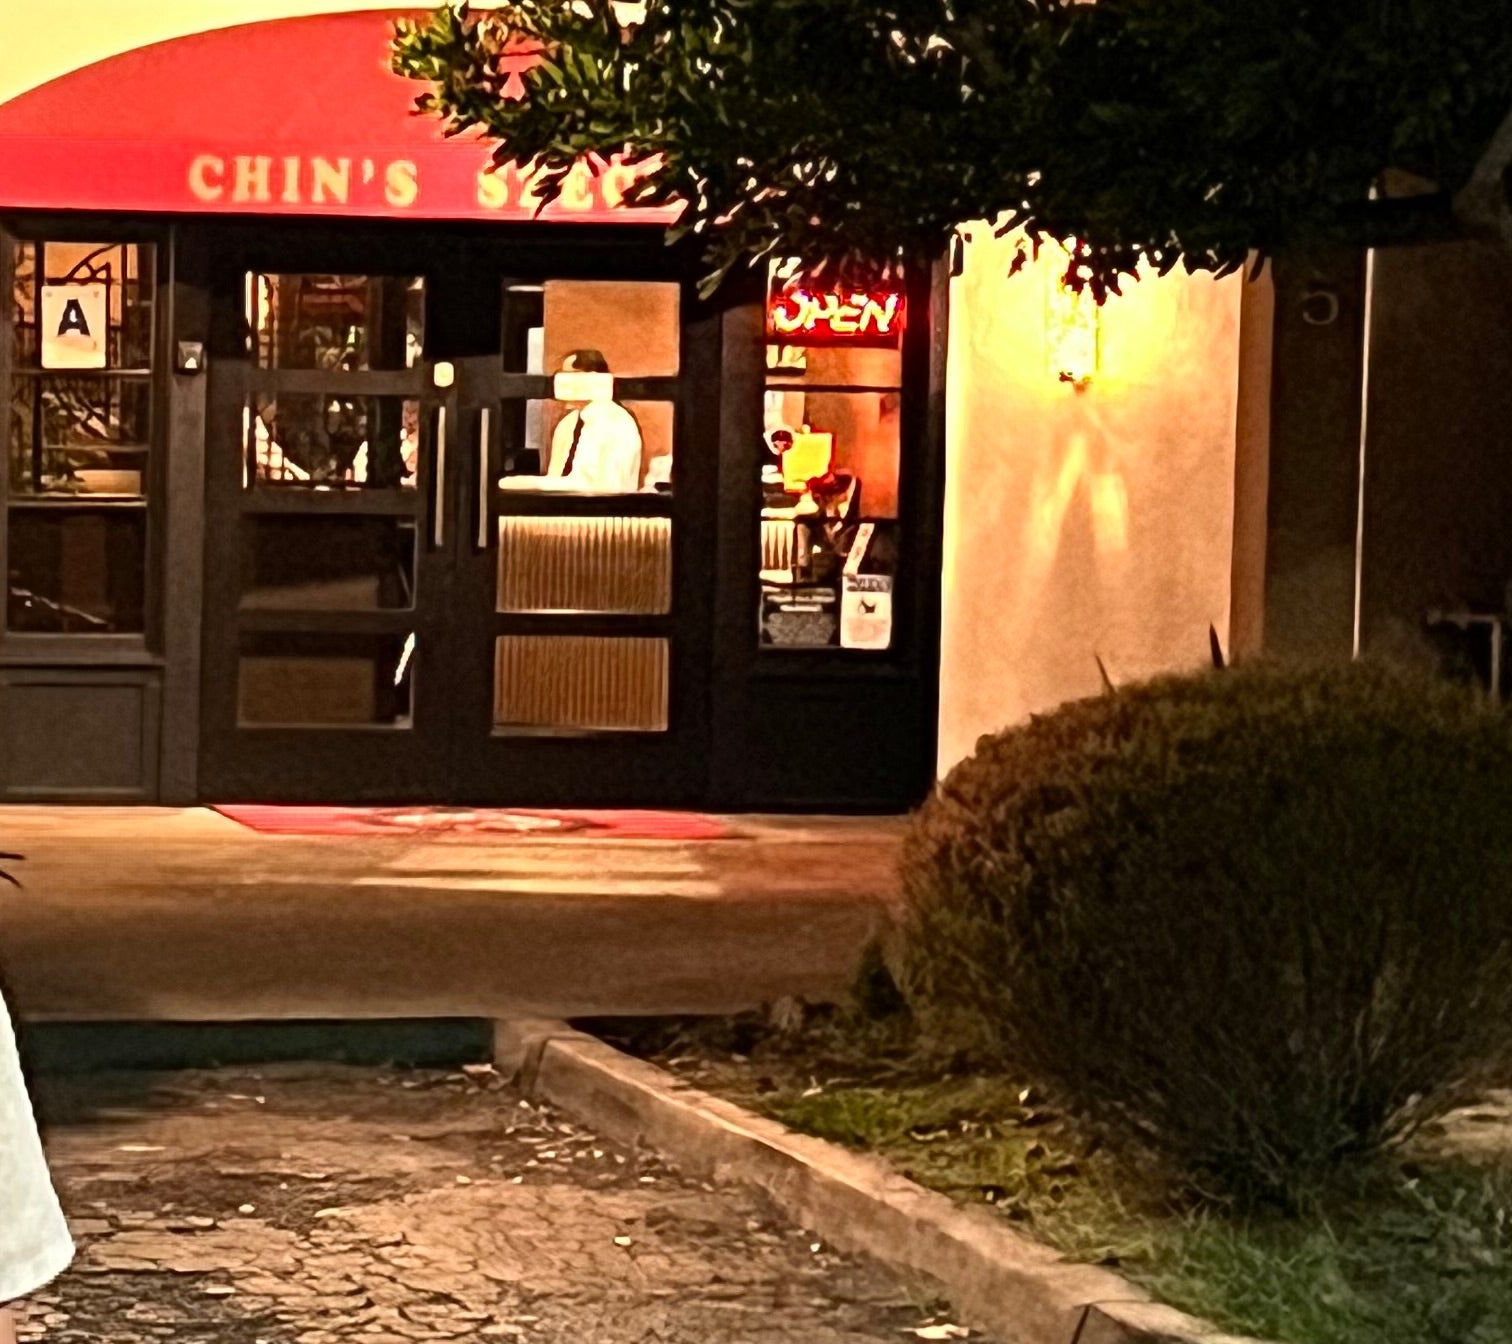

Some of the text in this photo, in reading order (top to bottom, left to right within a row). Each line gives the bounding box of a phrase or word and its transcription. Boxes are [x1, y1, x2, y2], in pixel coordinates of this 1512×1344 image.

[189, 155, 419, 208] CHIN'S
[56, 298, 91, 338] A
[773, 289, 899, 333] OPEN
